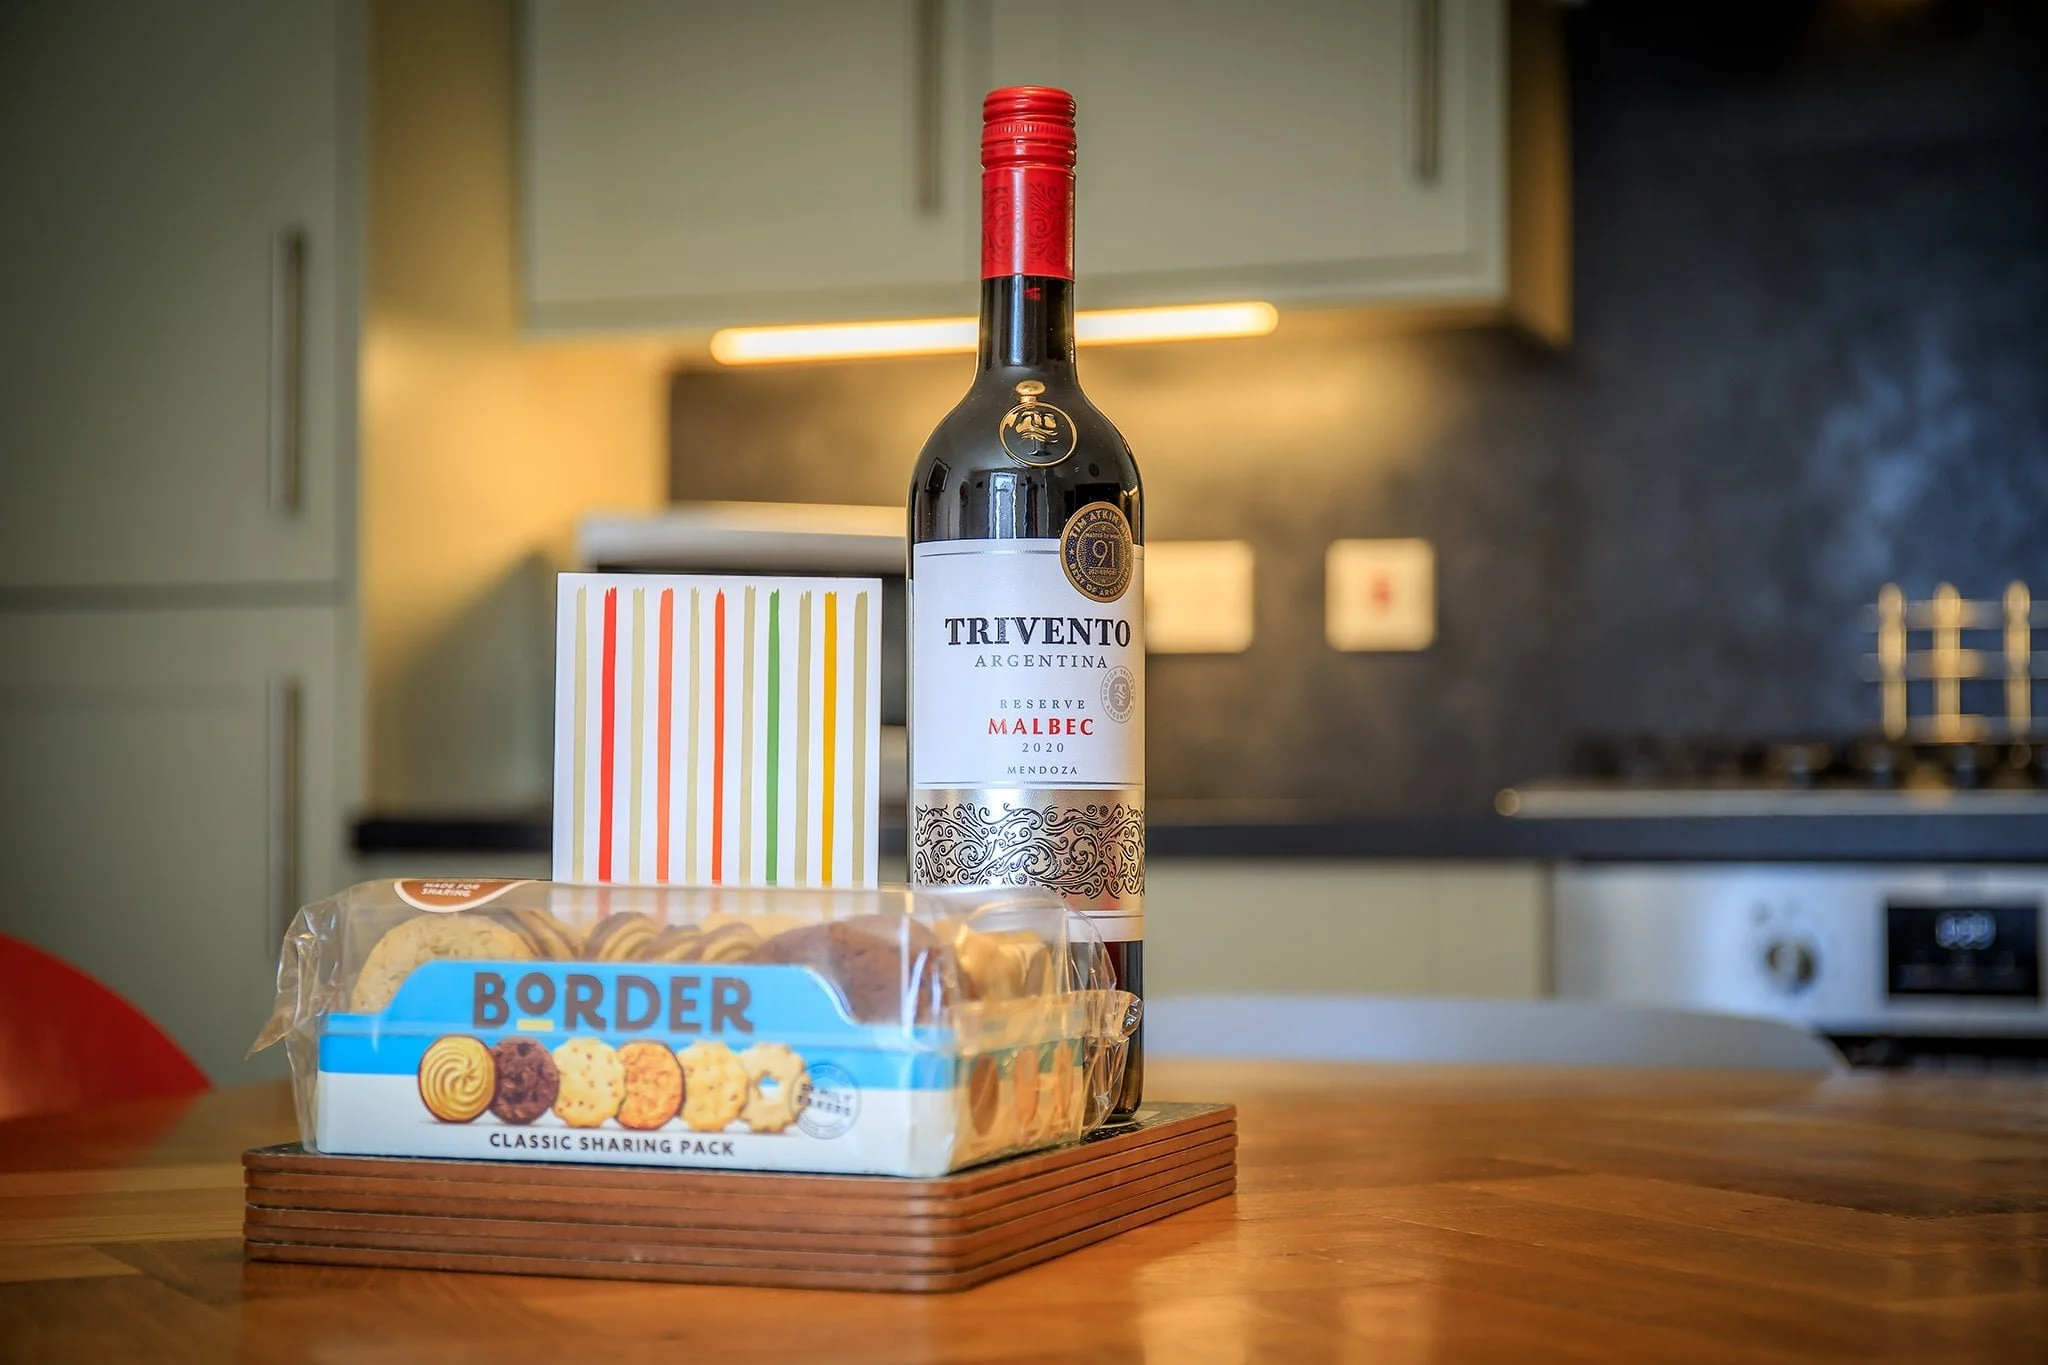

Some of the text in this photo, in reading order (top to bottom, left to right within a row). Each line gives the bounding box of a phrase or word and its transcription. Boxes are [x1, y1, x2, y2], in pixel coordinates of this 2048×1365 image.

[1093, 540, 1115, 567] 91
[944, 617, 1131, 647] TRIVENTO
[974, 654, 1108, 669] ARGENTINA
[1000, 699, 1086, 710] RESERVE
[988, 717, 1094, 736] MALBEC
[1022, 742, 1064, 753] 2020
[1007, 765, 1078, 775] MENDOZA
[421, 888, 471, 898] SHARING
[457, 883, 481, 891] FOR
[472, 971, 755, 1035] BORDER
[489, 1132, 736, 1157] CLASSIC SHARING PACK
